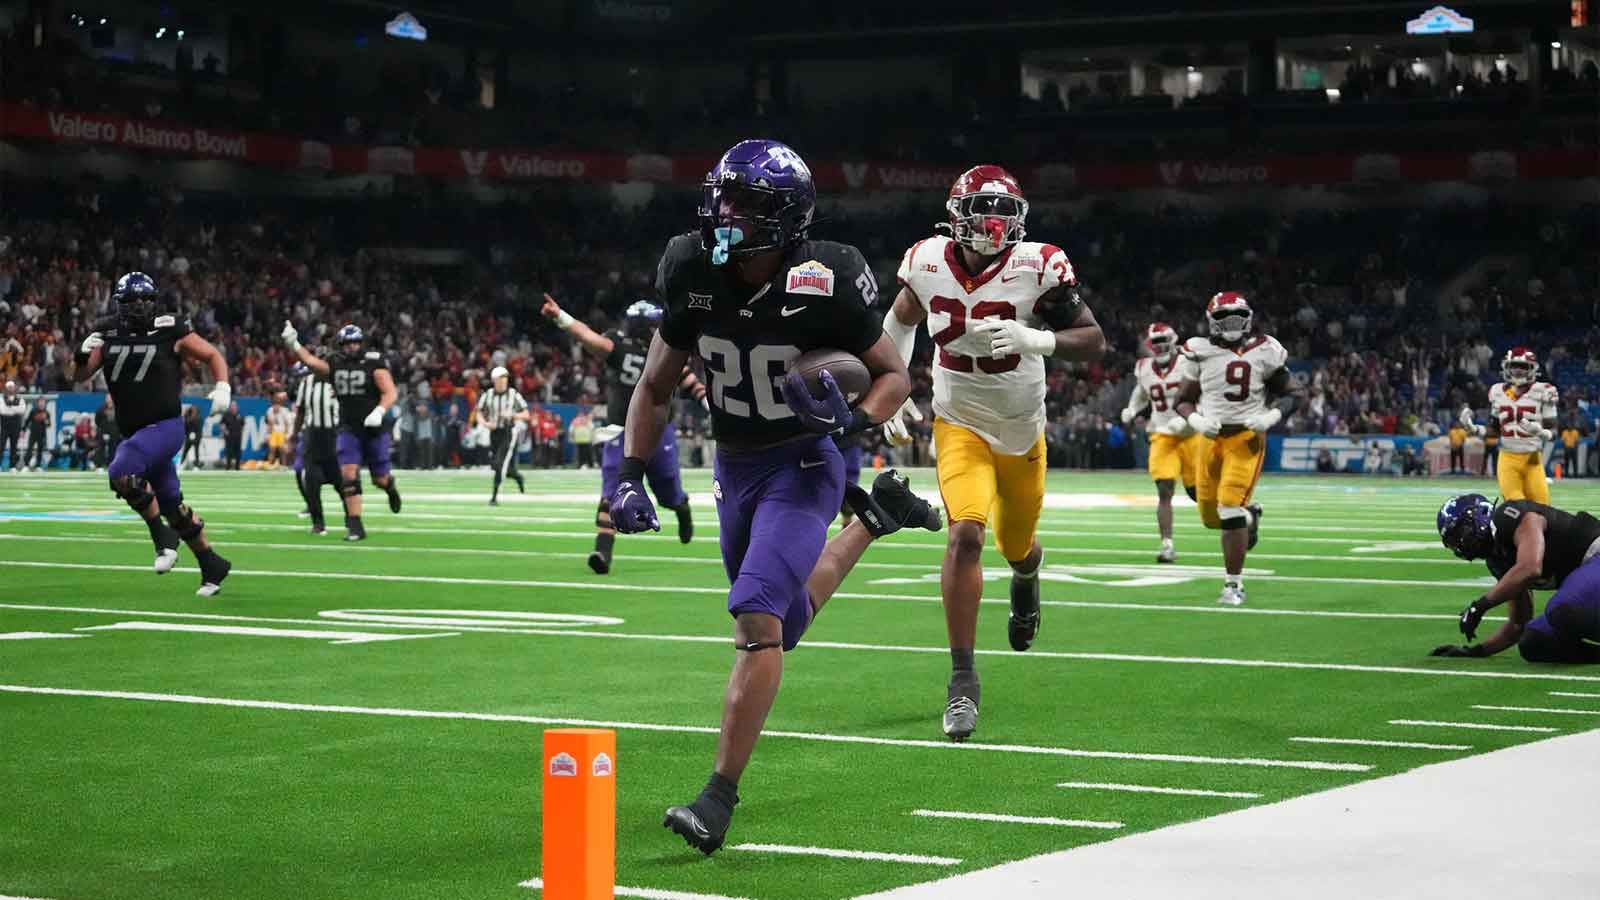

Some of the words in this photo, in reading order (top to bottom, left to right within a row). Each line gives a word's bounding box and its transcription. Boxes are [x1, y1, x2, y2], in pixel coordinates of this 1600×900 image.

[48, 112, 116, 142] Valero
[122, 120, 191, 150] Alamo
[194, 130, 248, 156] Bowl
[500, 154, 587, 177] Valero
[108, 344, 156, 382] 77
[1224, 360, 1252, 401] 9
[335, 369, 366, 396] 62
